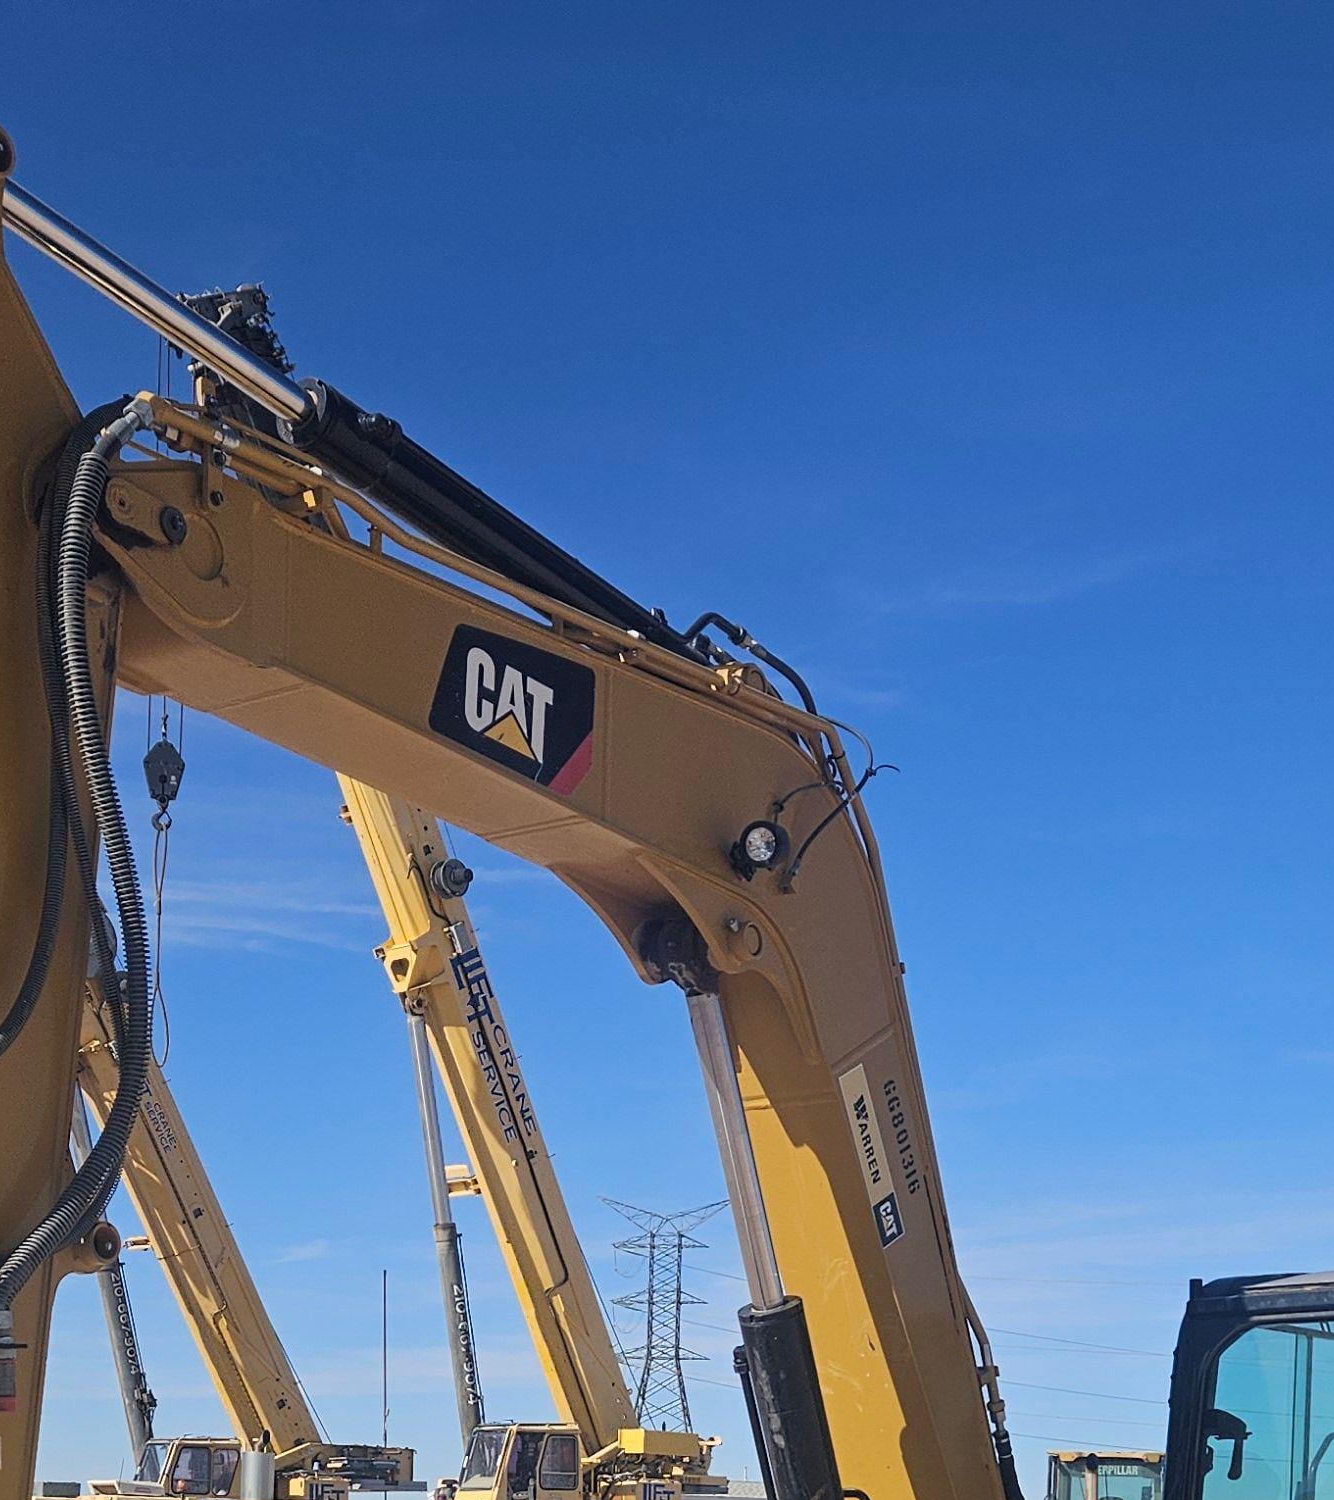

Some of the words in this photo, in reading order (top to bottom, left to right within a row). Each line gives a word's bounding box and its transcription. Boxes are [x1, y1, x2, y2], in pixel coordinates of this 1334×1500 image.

[465, 647, 553, 764] CAT
[145, 1101, 171, 1153] SERVICE
[154, 1102, 176, 1146] CRANE
[472, 1030, 517, 1143] SERVICE
[494, 1024, 537, 1136] CRANE
[853, 1094, 882, 1184] WARREN
[879, 1200, 899, 1238] CAT
[111, 1272, 139, 1375] 210-667-9074
[1098, 1465, 1138, 1475] ERPILLAR
